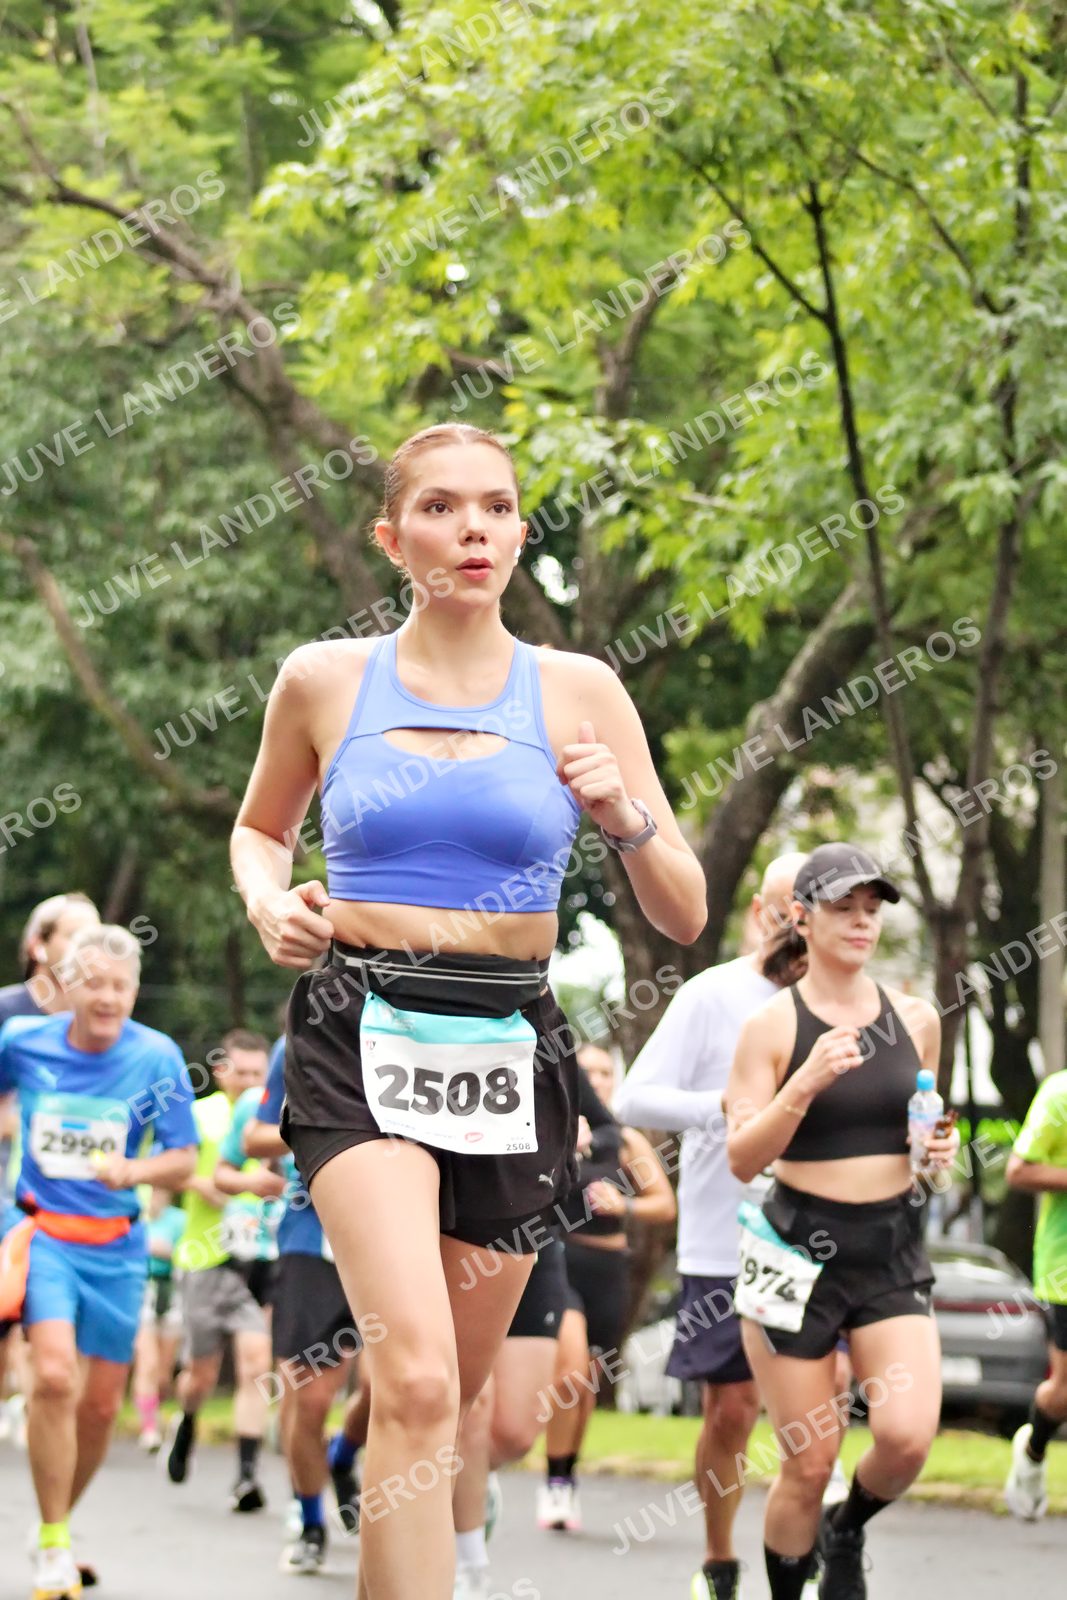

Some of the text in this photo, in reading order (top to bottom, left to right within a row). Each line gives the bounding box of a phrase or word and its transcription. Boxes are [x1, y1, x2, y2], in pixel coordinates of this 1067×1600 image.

[374, 1064, 521, 1116] 2508
[506, 1142, 531, 1151] 2508
[741, 1250, 798, 1302] 974
